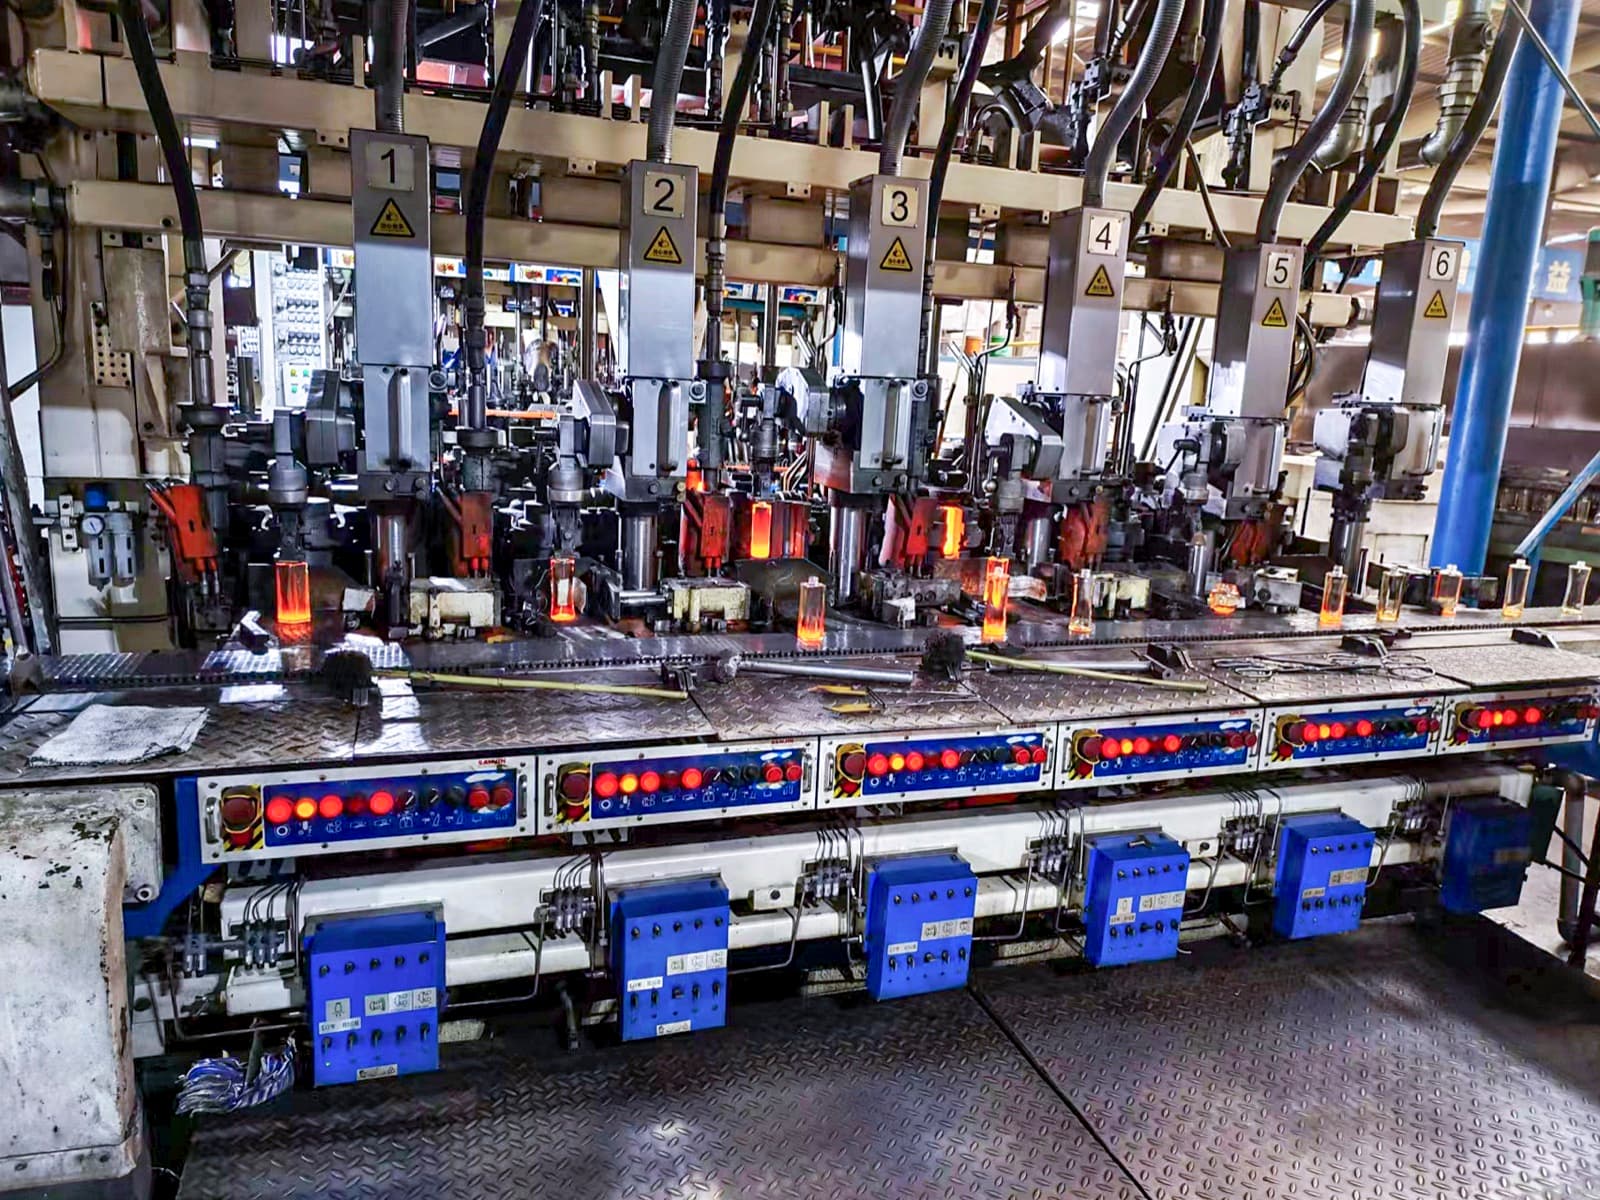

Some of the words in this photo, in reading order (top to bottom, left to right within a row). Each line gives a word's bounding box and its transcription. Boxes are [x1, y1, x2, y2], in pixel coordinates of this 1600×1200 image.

[381, 148, 395, 184] 1
[653, 178, 674, 212] 2
[890, 190, 909, 222] 3
[1095, 221, 1112, 250] 4
[1273, 257, 1289, 284] 5
[1436, 250, 1450, 276] 6
